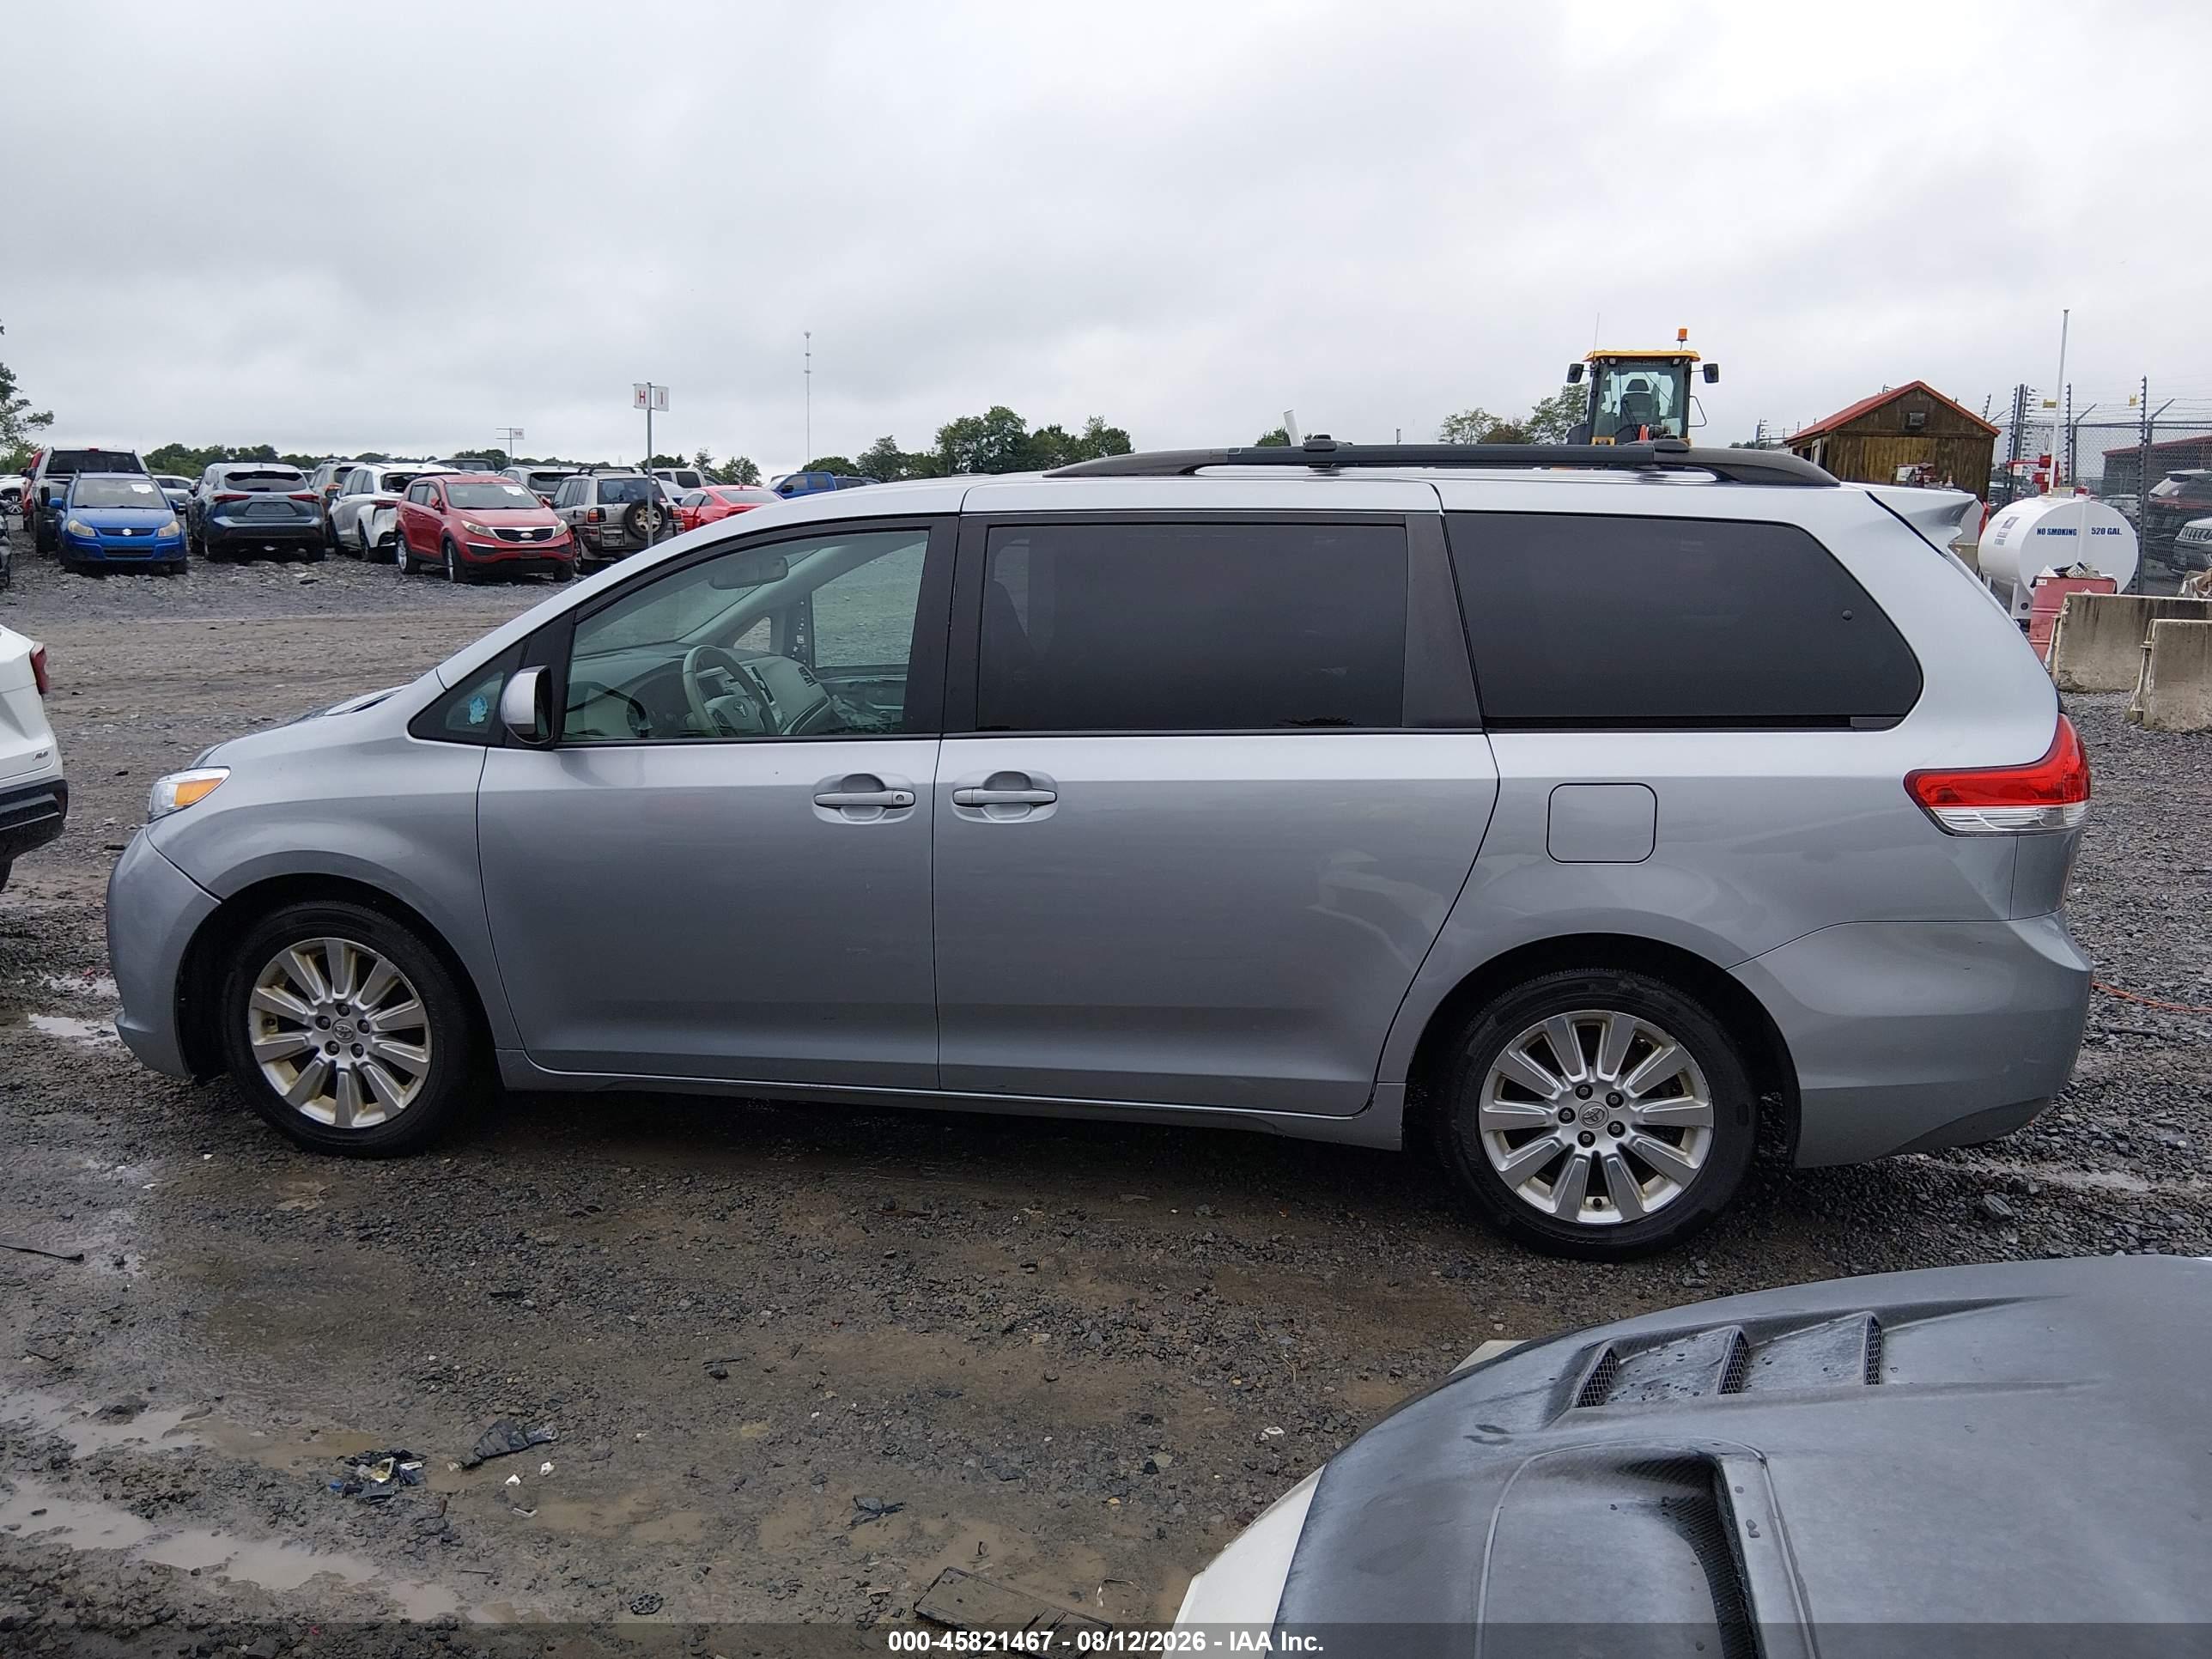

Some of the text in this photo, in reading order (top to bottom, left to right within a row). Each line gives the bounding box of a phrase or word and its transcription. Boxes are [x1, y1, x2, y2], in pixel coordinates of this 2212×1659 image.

[639, 390, 646, 404] H
[2036, 527, 2046, 536] NO
[2091, 526, 2106, 535] 520
